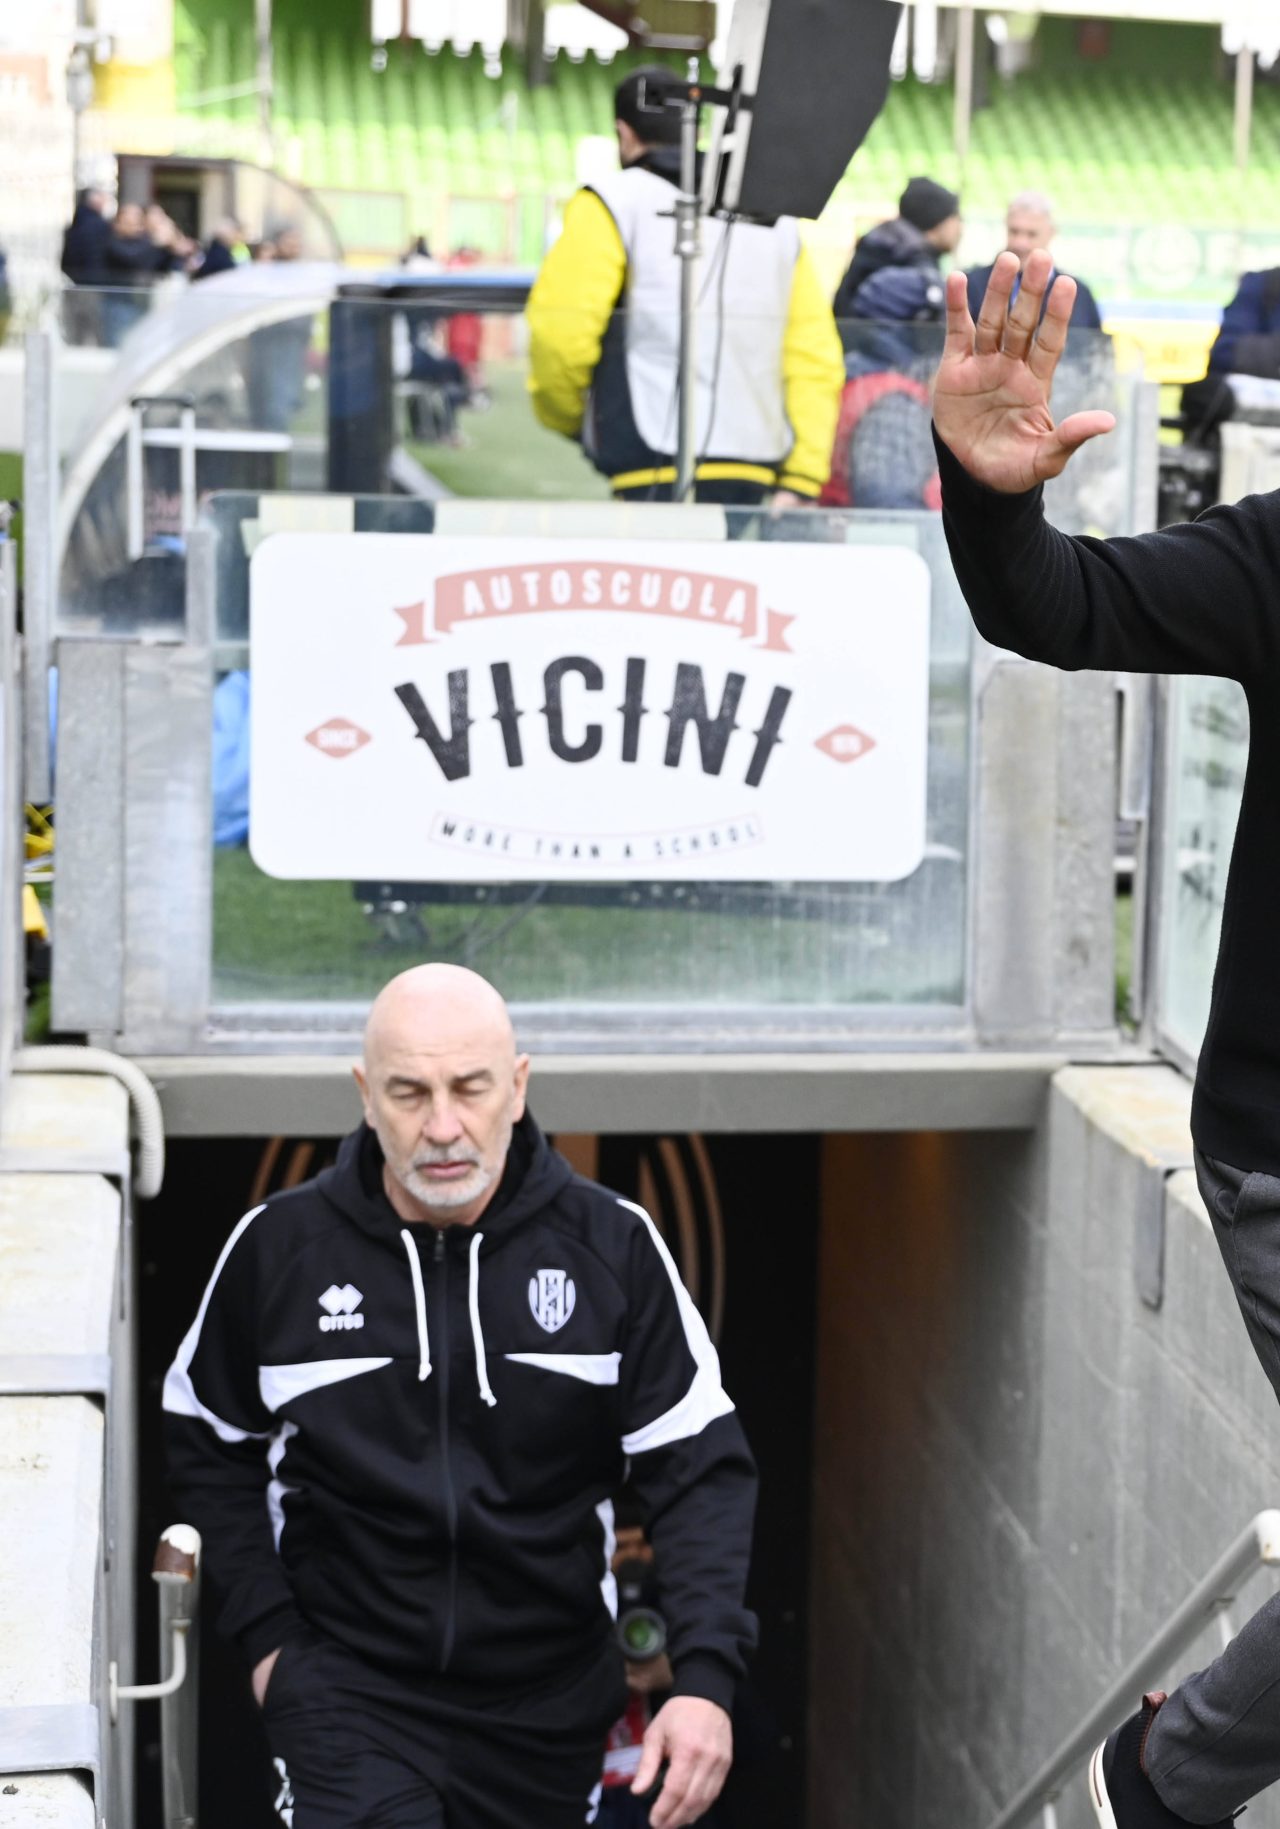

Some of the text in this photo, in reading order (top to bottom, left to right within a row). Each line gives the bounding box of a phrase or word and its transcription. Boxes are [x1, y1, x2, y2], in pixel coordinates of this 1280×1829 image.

[463, 568, 746, 622] AUTOSCUOLA
[394, 655, 793, 788] VICINI
[442, 820, 757, 858] MORE THAN A SCHOOL
